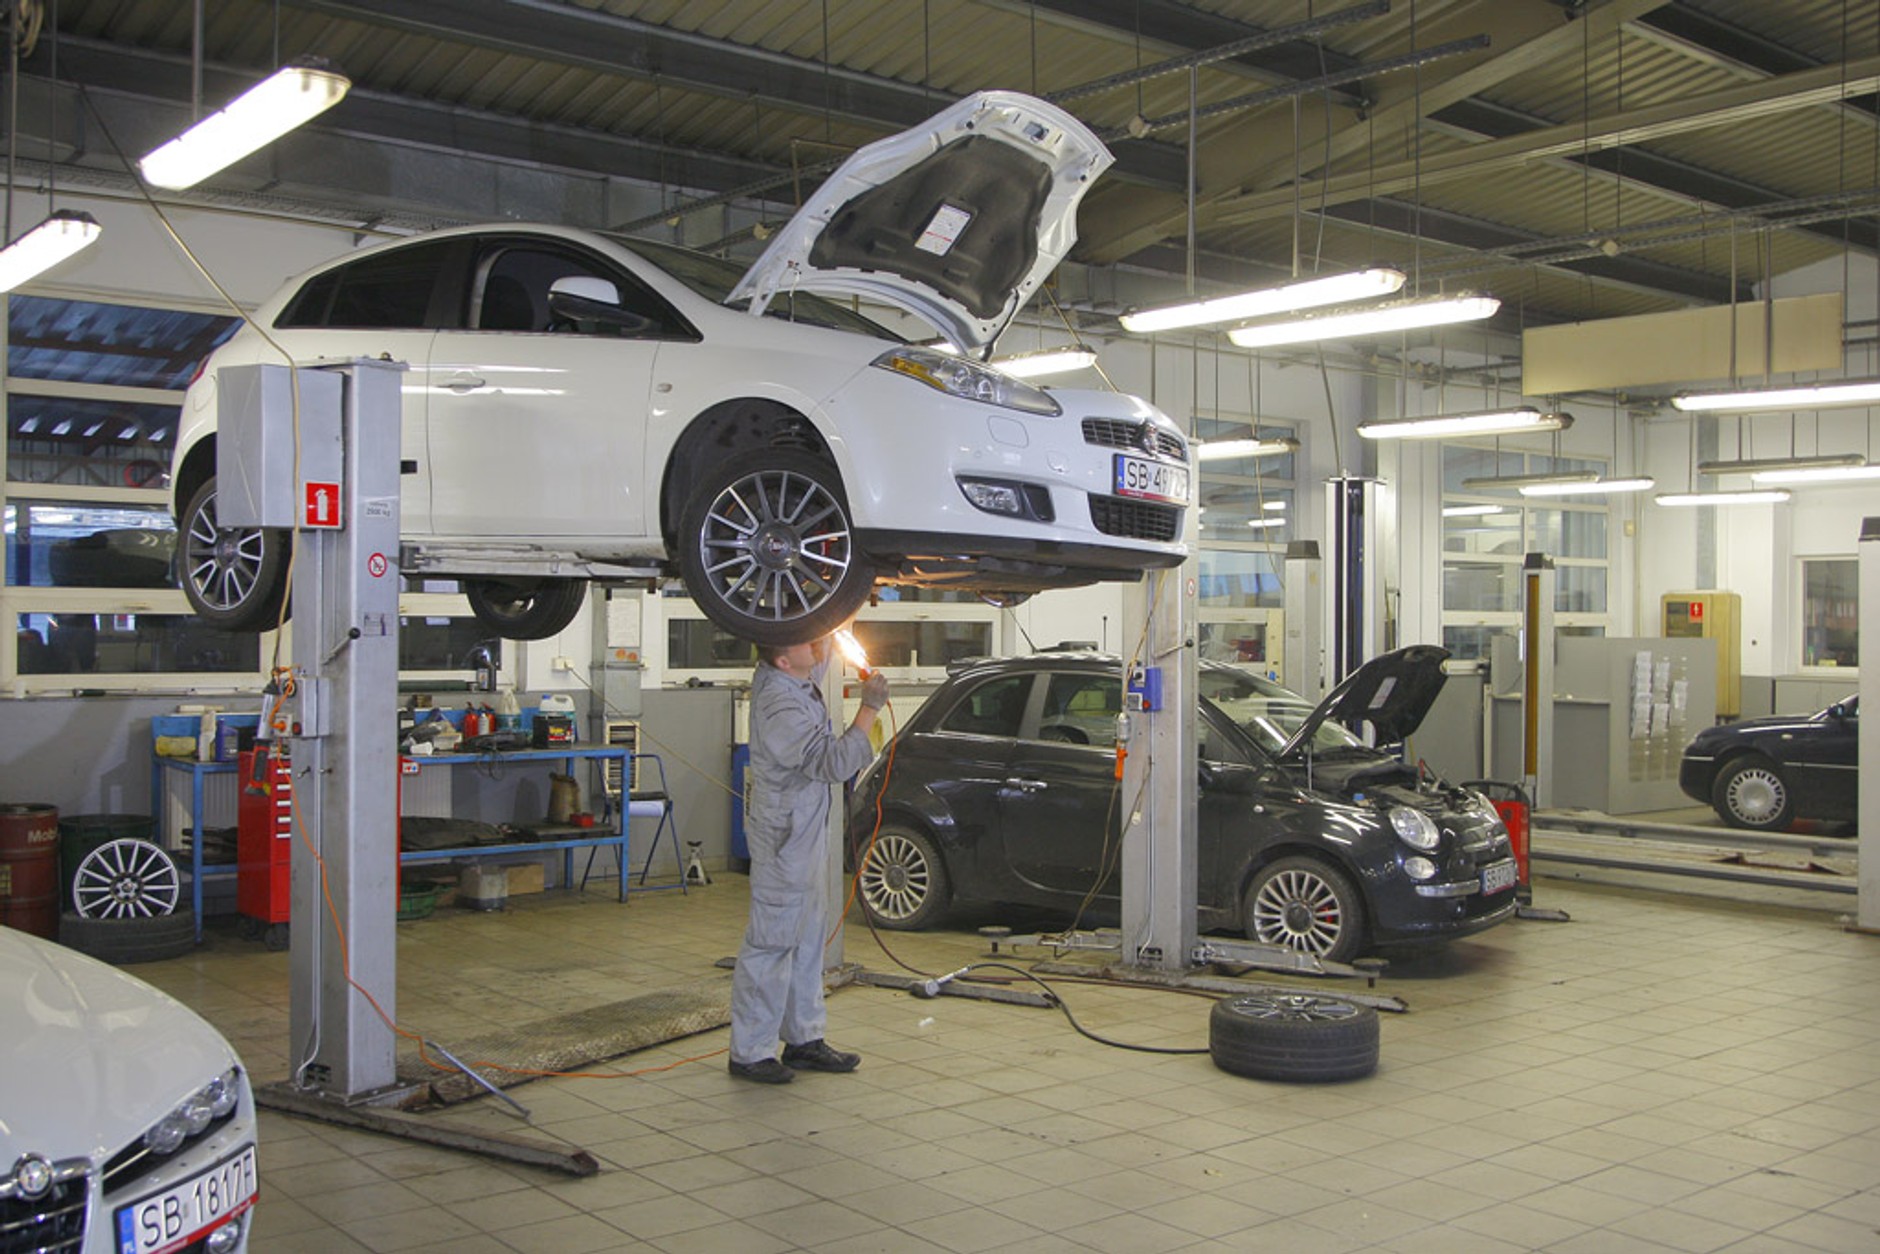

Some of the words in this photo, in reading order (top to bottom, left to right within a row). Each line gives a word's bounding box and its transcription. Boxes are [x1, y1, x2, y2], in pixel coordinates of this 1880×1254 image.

[1127, 461, 1148, 490] SB
[140, 1195, 182, 1248] SB
[192, 1150, 253, 1224] 1817F
